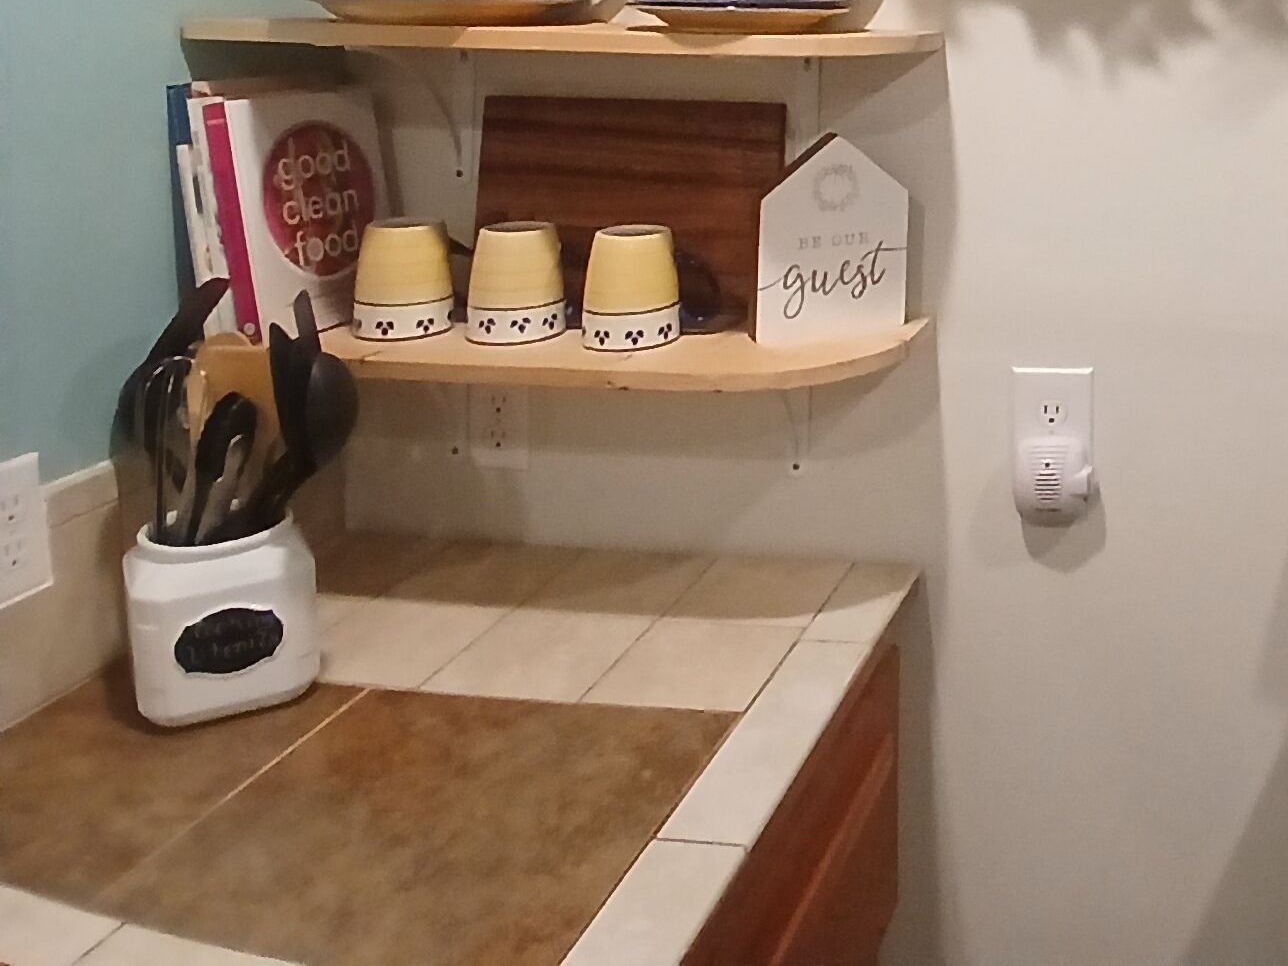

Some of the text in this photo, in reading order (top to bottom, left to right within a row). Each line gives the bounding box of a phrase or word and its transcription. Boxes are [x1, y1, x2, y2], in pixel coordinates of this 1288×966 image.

[278, 139, 350, 191] good
[283, 189, 359, 225] clean
[295, 220, 359, 266] food
[798, 232, 870, 250] BE OUR
[758, 241, 907, 319] guest
